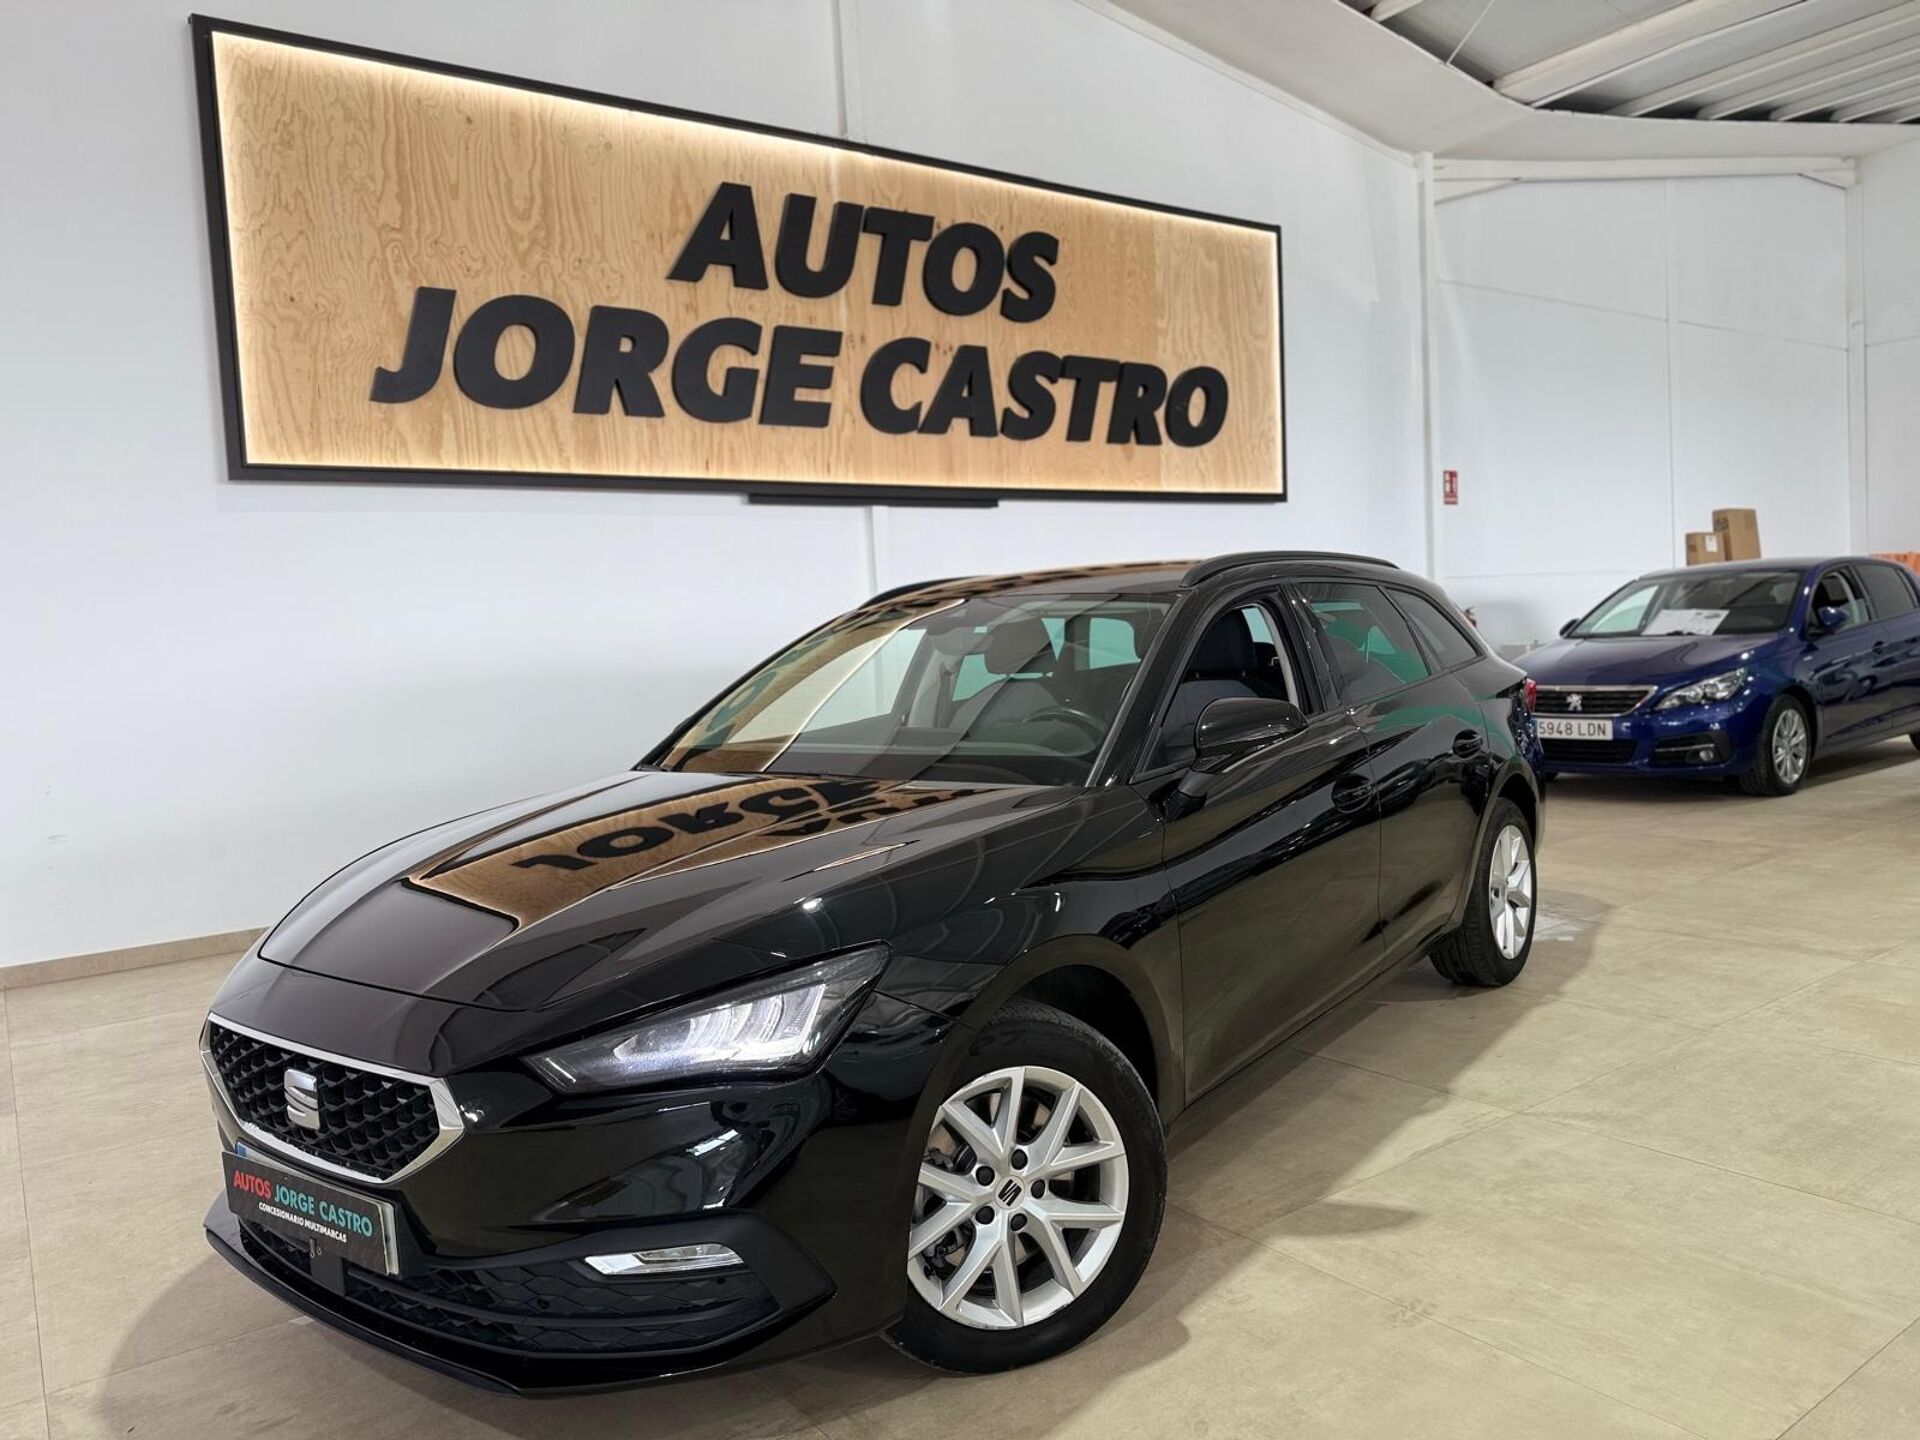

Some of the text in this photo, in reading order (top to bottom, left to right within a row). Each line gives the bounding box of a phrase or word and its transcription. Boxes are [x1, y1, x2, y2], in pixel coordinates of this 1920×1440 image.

[667, 181, 1059, 322] AUTOS
[371, 286, 1229, 448] JORGE CASTRO
[1539, 722, 1606, 737] 5948 LDN
[233, 1170, 373, 1237] AUTOS JORGE CASTRO
[258, 1202, 347, 1243] CONCESIONARIO MULTIMARCAS
